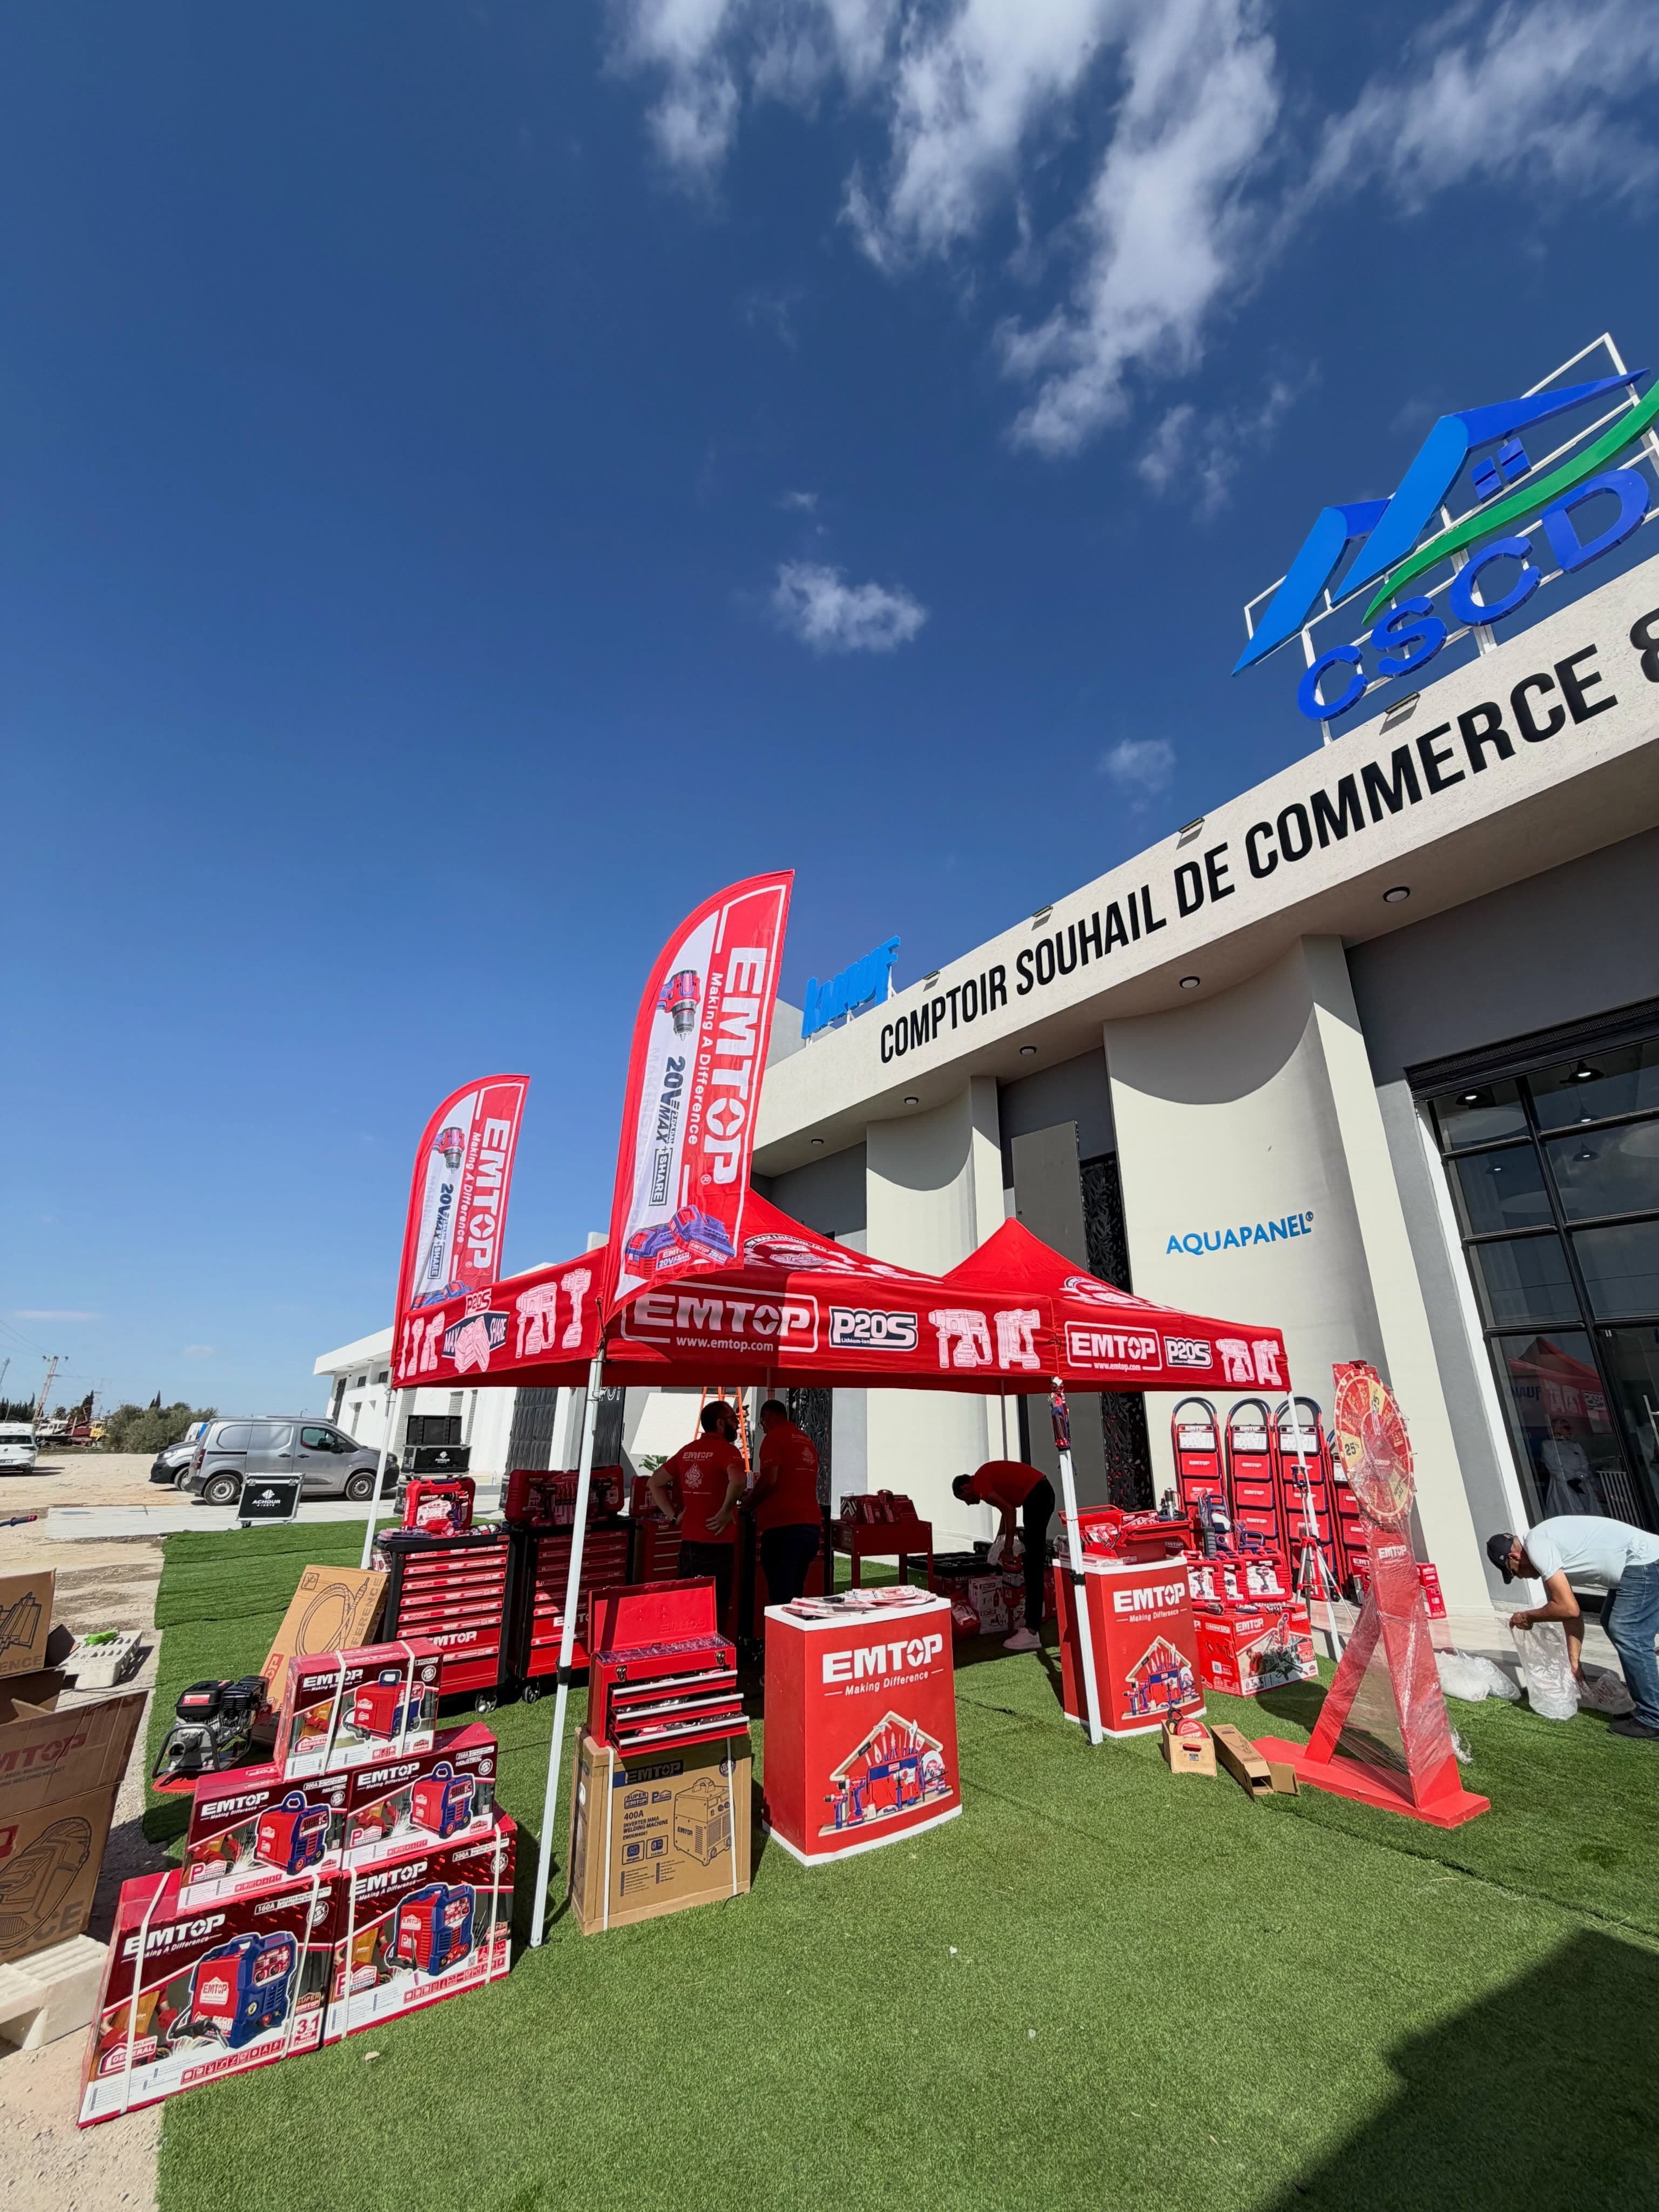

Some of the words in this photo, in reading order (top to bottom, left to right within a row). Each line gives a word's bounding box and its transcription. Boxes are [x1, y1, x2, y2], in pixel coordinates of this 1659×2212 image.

[1297, 469, 1651, 721] CSCD
[880, 964, 1008, 1064] COMPTOIR
[1016, 884, 1167, 996] SOUHAIL
[1174, 841, 1236, 919] DE
[1245, 643, 1618, 879] COMMERCE
[702, 973, 724, 1032] Making
[702, 1035, 713, 1048] A
[688, 1055, 712, 1145] Difference
[466, 1132, 481, 1170] Making
[652, 1153, 670, 1203] SHARE
[457, 1183, 473, 1243] Difference
[633, 1293, 811, 1337] EMTOP
[489, 1318, 507, 1346] SHARE
[833, 1311, 917, 1346] P20S
[676, 1337, 774, 1353] www.emtop.com
[1071, 1331, 1156, 1360] EMTOP
[1166, 1339, 1210, 1367] P20S
[1093, 1362, 1142, 1373] www.emtop.com
[1353, 1557, 1370, 1566] EMT
[1378, 1545, 1407, 1559] EMTOP
[1113, 1582, 1185, 1613] EMTOP
[352, 1577, 383, 1645] FERENCE
[1129, 1611, 1151, 1623] Making
[1153, 1609, 1179, 1620] Difference
[822, 1633, 943, 1684] EMTOP
[845, 1681, 880, 1696] Making
[884, 1671, 929, 1689] Difference
[0, 1732, 88, 1772] MTOP
[358, 1762, 420, 1786] EMTOP
[626, 1762, 682, 1784] EMTOP
[200, 1791, 269, 1817] EMTOP
[626, 1792, 646, 1800] SUPER
[230, 1805, 258, 1816] Difference
[624, 1810, 644, 1820] 400A
[454, 1851, 469, 1860] 200A
[190, 1864, 204, 1882] P
[349, 1862, 428, 1897] EMTOP
[359, 1890, 380, 1901] Making
[386, 1880, 417, 1892] Difference
[258, 1903, 275, 1912] 160A
[122, 1913, 226, 1957] EMTOP
[171, 1936, 210, 1953] Difference
[203, 1984, 227, 1994] EMTOP
[296, 2019, 308, 2034] 3
[311, 2013, 320, 2030] 1
[111, 2044, 154, 2063] GEERAL
